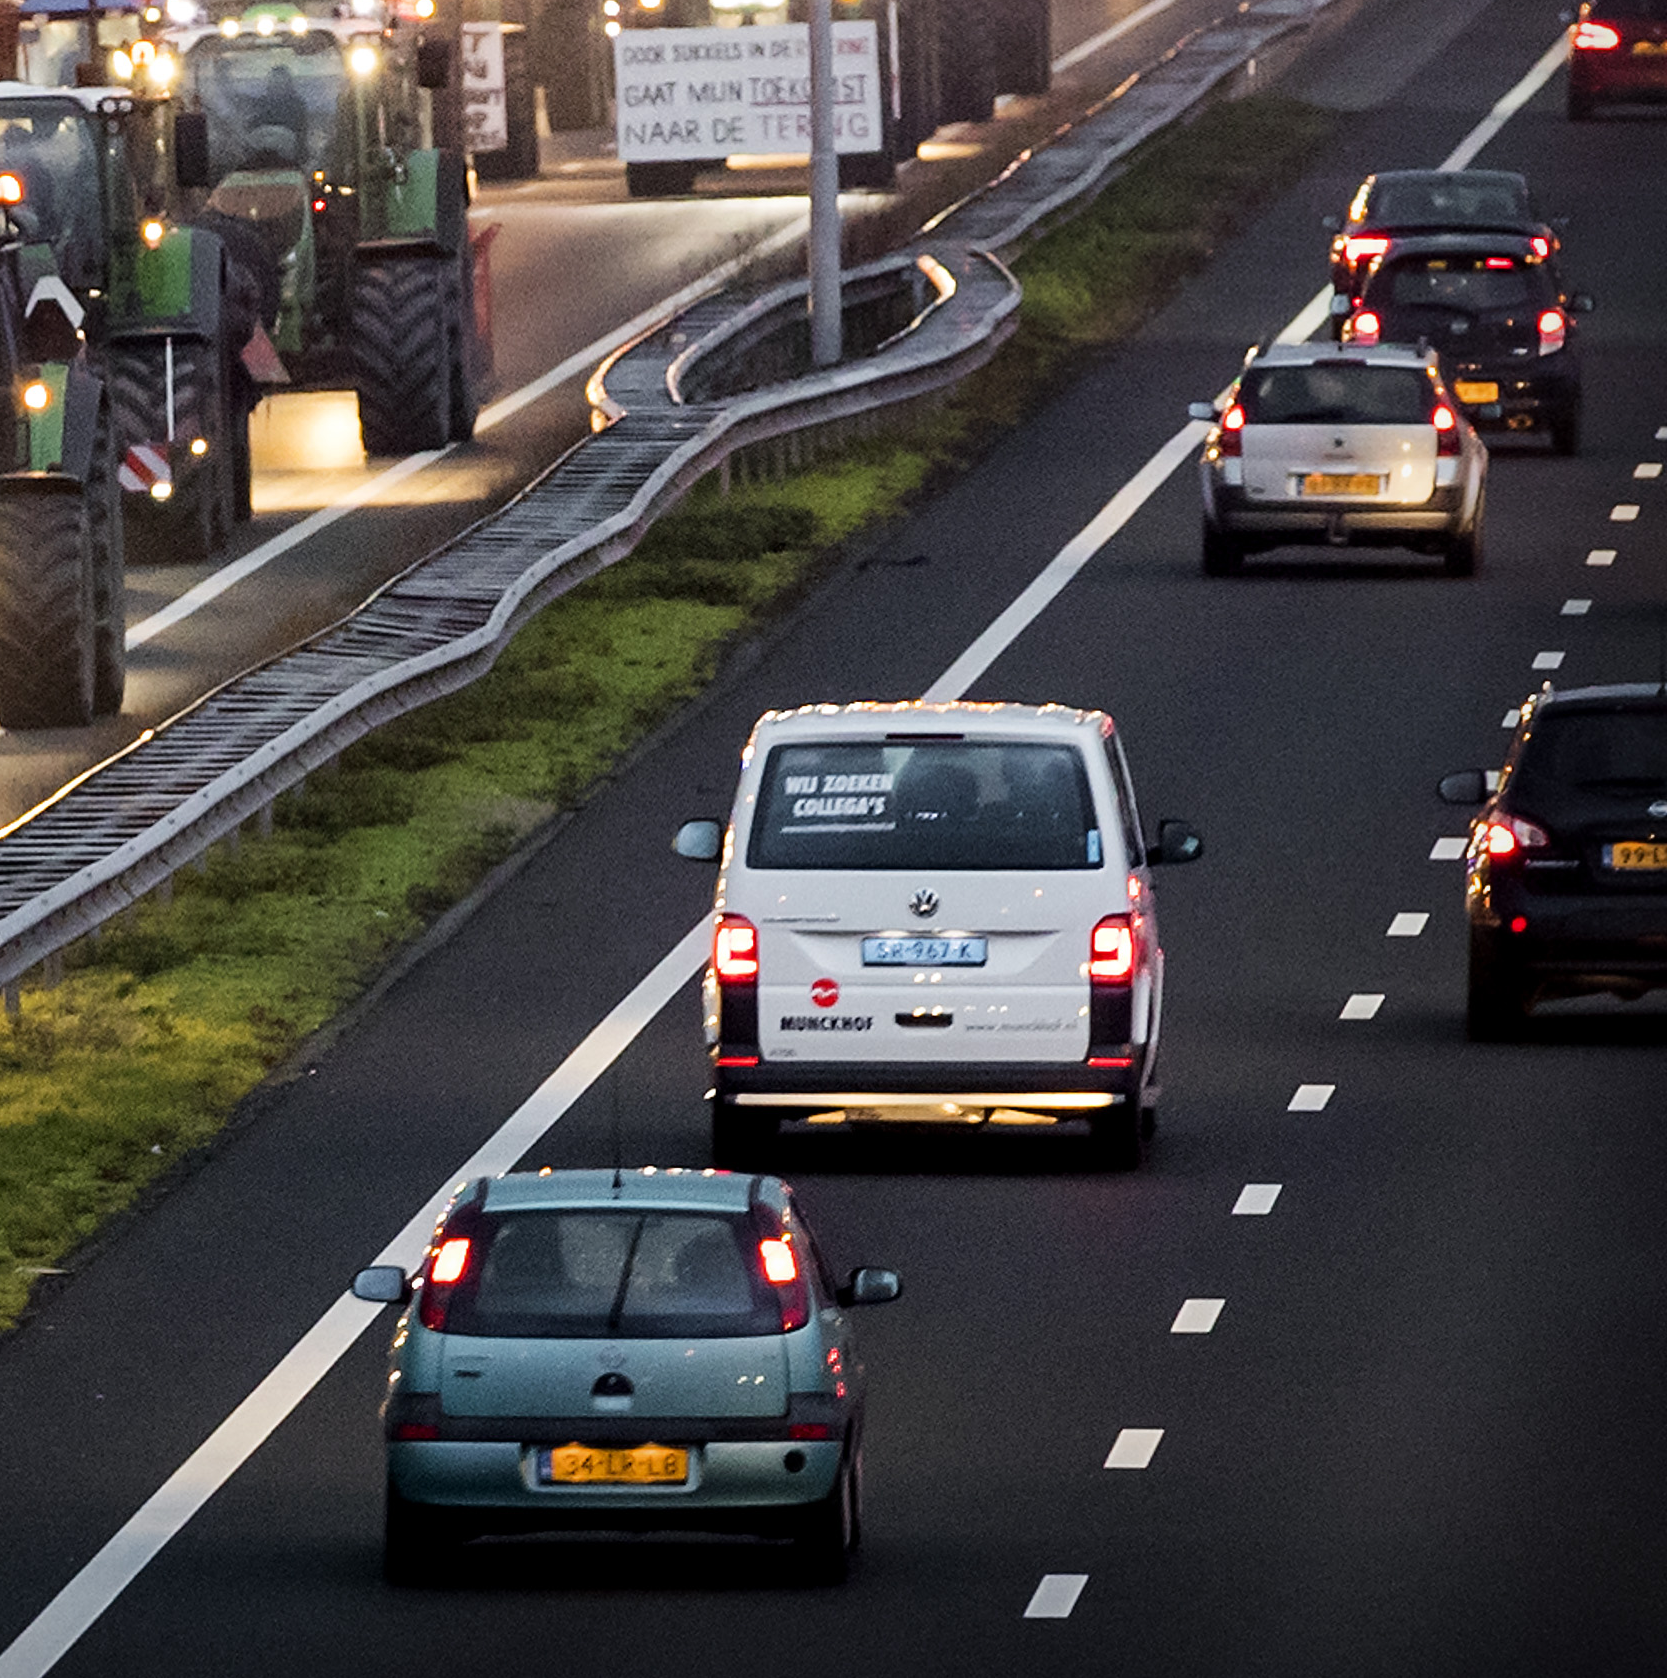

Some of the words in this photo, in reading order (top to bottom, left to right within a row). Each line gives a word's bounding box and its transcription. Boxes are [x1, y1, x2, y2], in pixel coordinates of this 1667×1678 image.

[624, 80, 677, 108] GAAT
[687, 80, 743, 103] MIJN
[624, 119, 702, 145] NAAR
[712, 116, 746, 144] DE
[785, 776, 819, 794] WIJ
[821, 773, 894, 793] ZOEKEN
[792, 796, 886, 817] COLLEGA'S
[780, 1015, 873, 1031] MUNCKHOF
